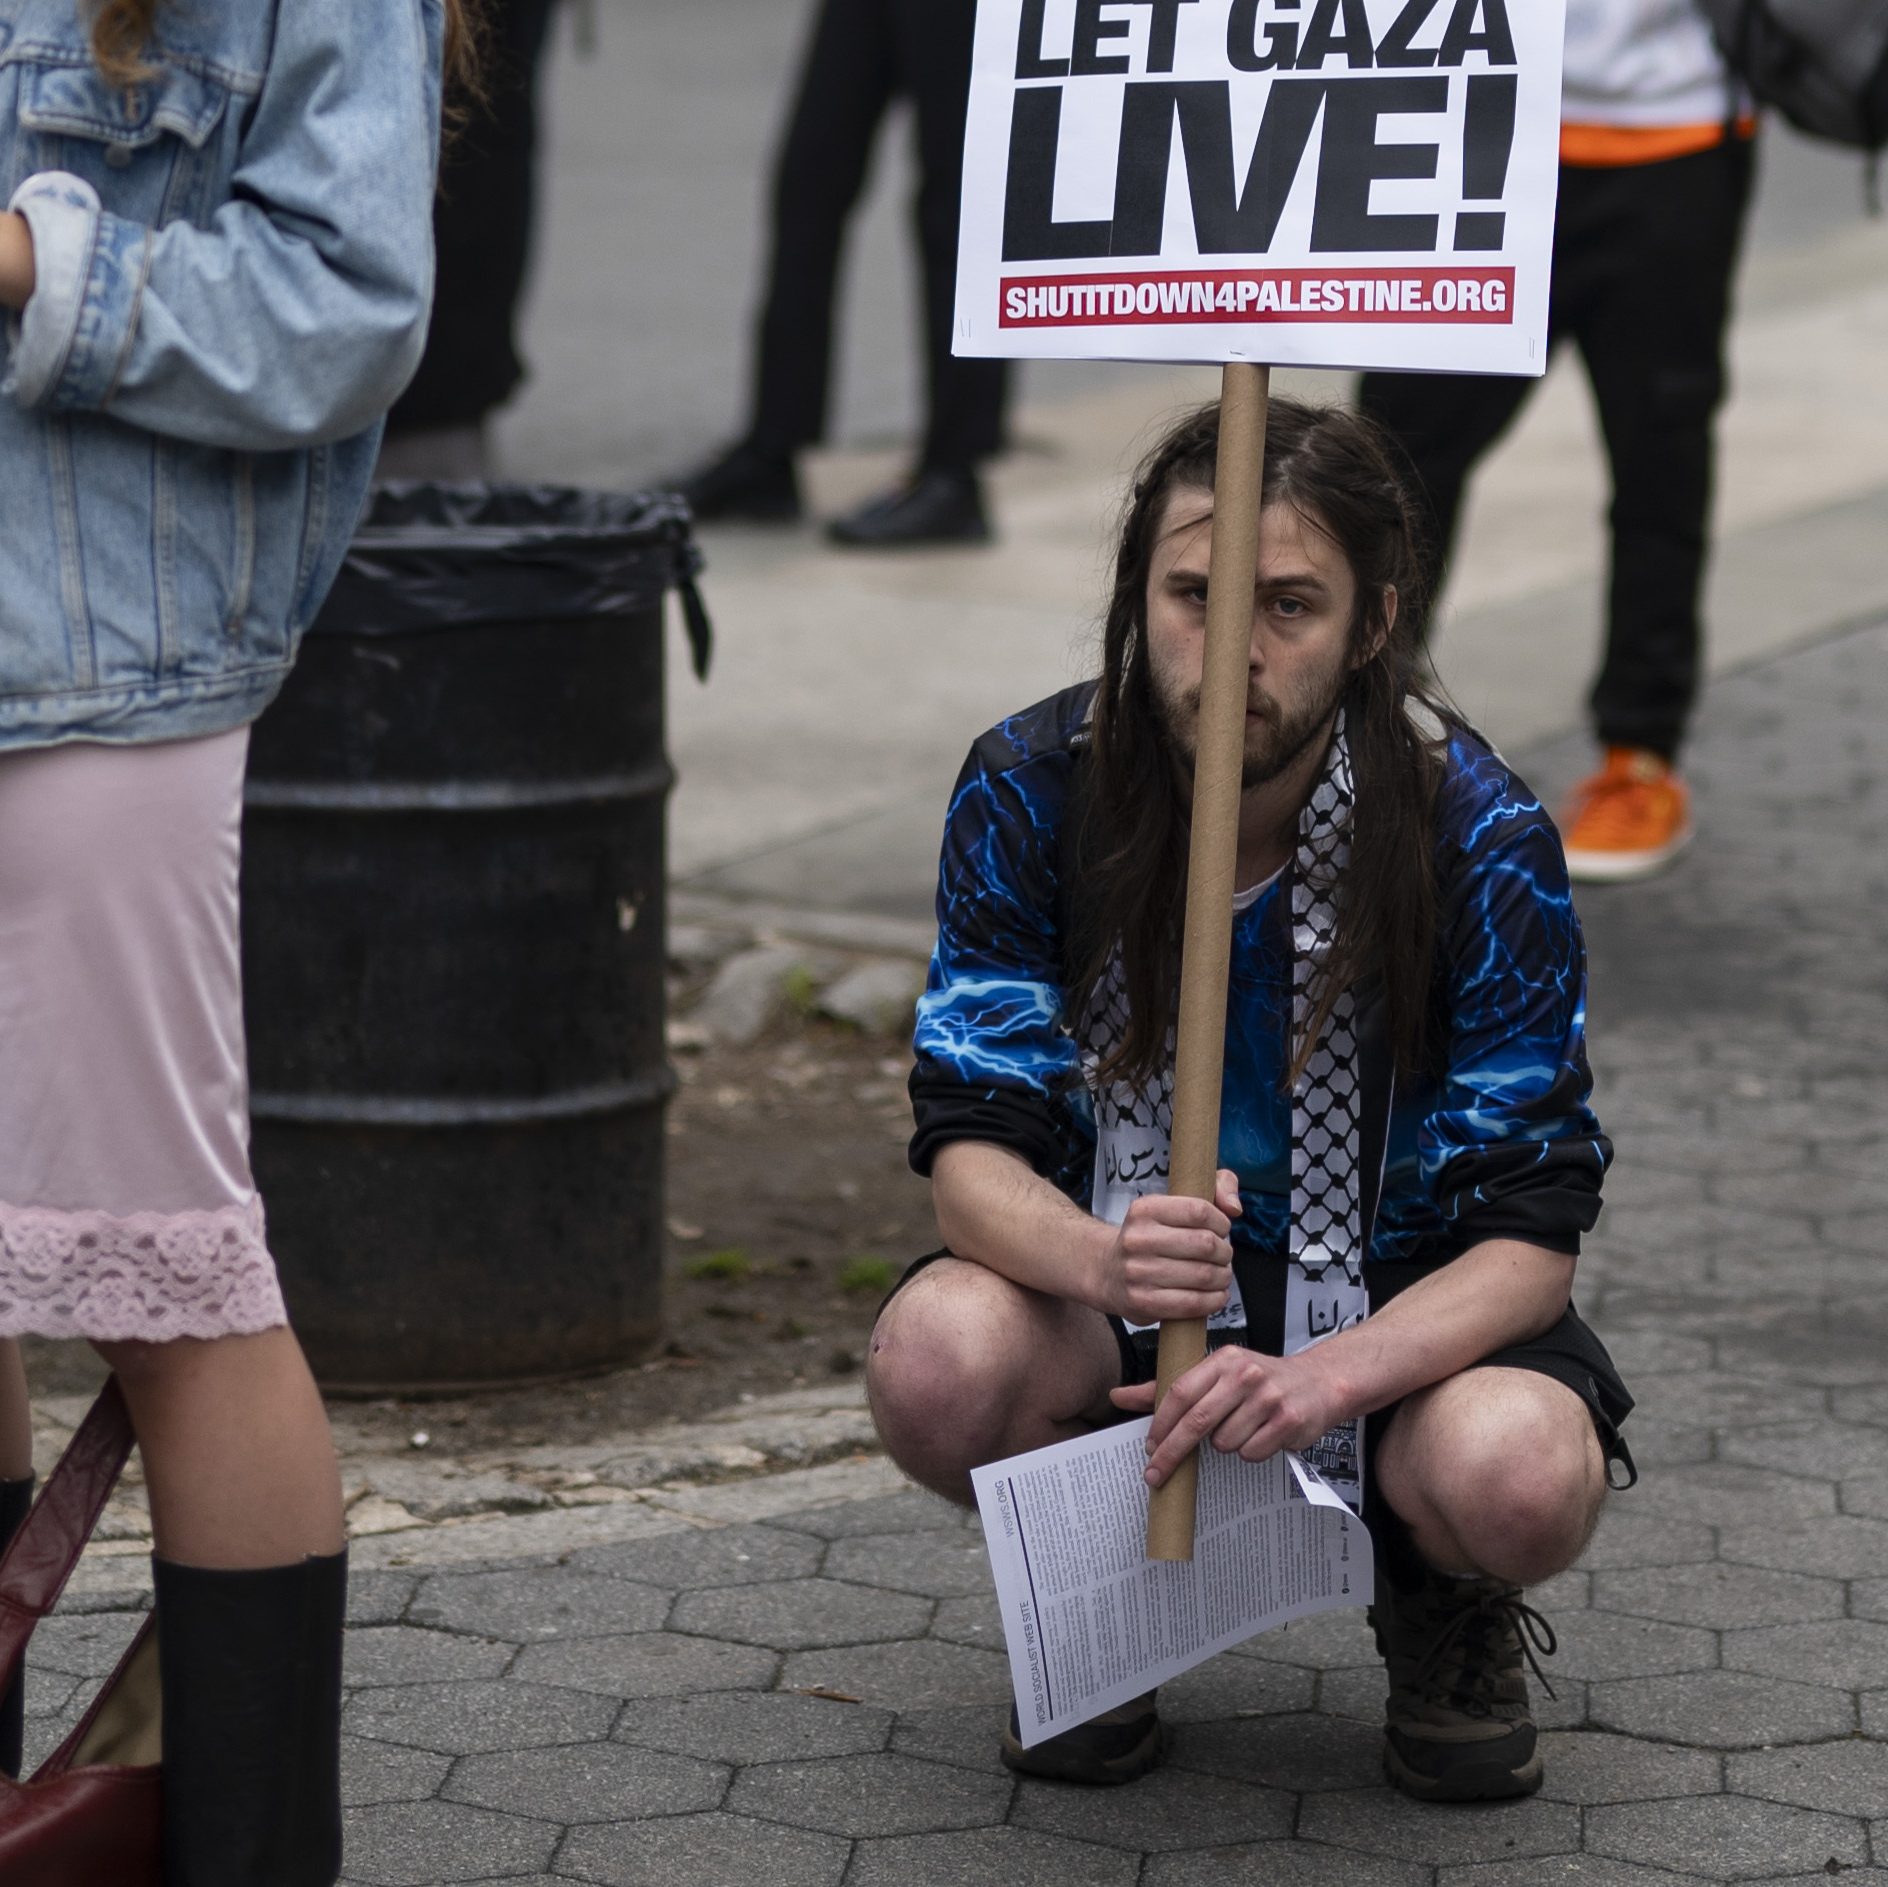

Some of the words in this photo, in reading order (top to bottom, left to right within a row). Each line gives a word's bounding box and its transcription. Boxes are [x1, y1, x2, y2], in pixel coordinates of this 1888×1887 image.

[1001, 73, 1518, 262] LIVE!
[1005, 279, 1507, 319] SHUTITDOWN4PALESTINE.ORG
[994, 1480, 1015, 1537] WSWS.ORG
[1019, 1600, 1032, 1622] SITE
[1024, 1622, 1035, 1645] WEB
[1027, 1647, 1043, 1693] SOCIALIST
[1035, 1693, 1046, 1726] WORLD
